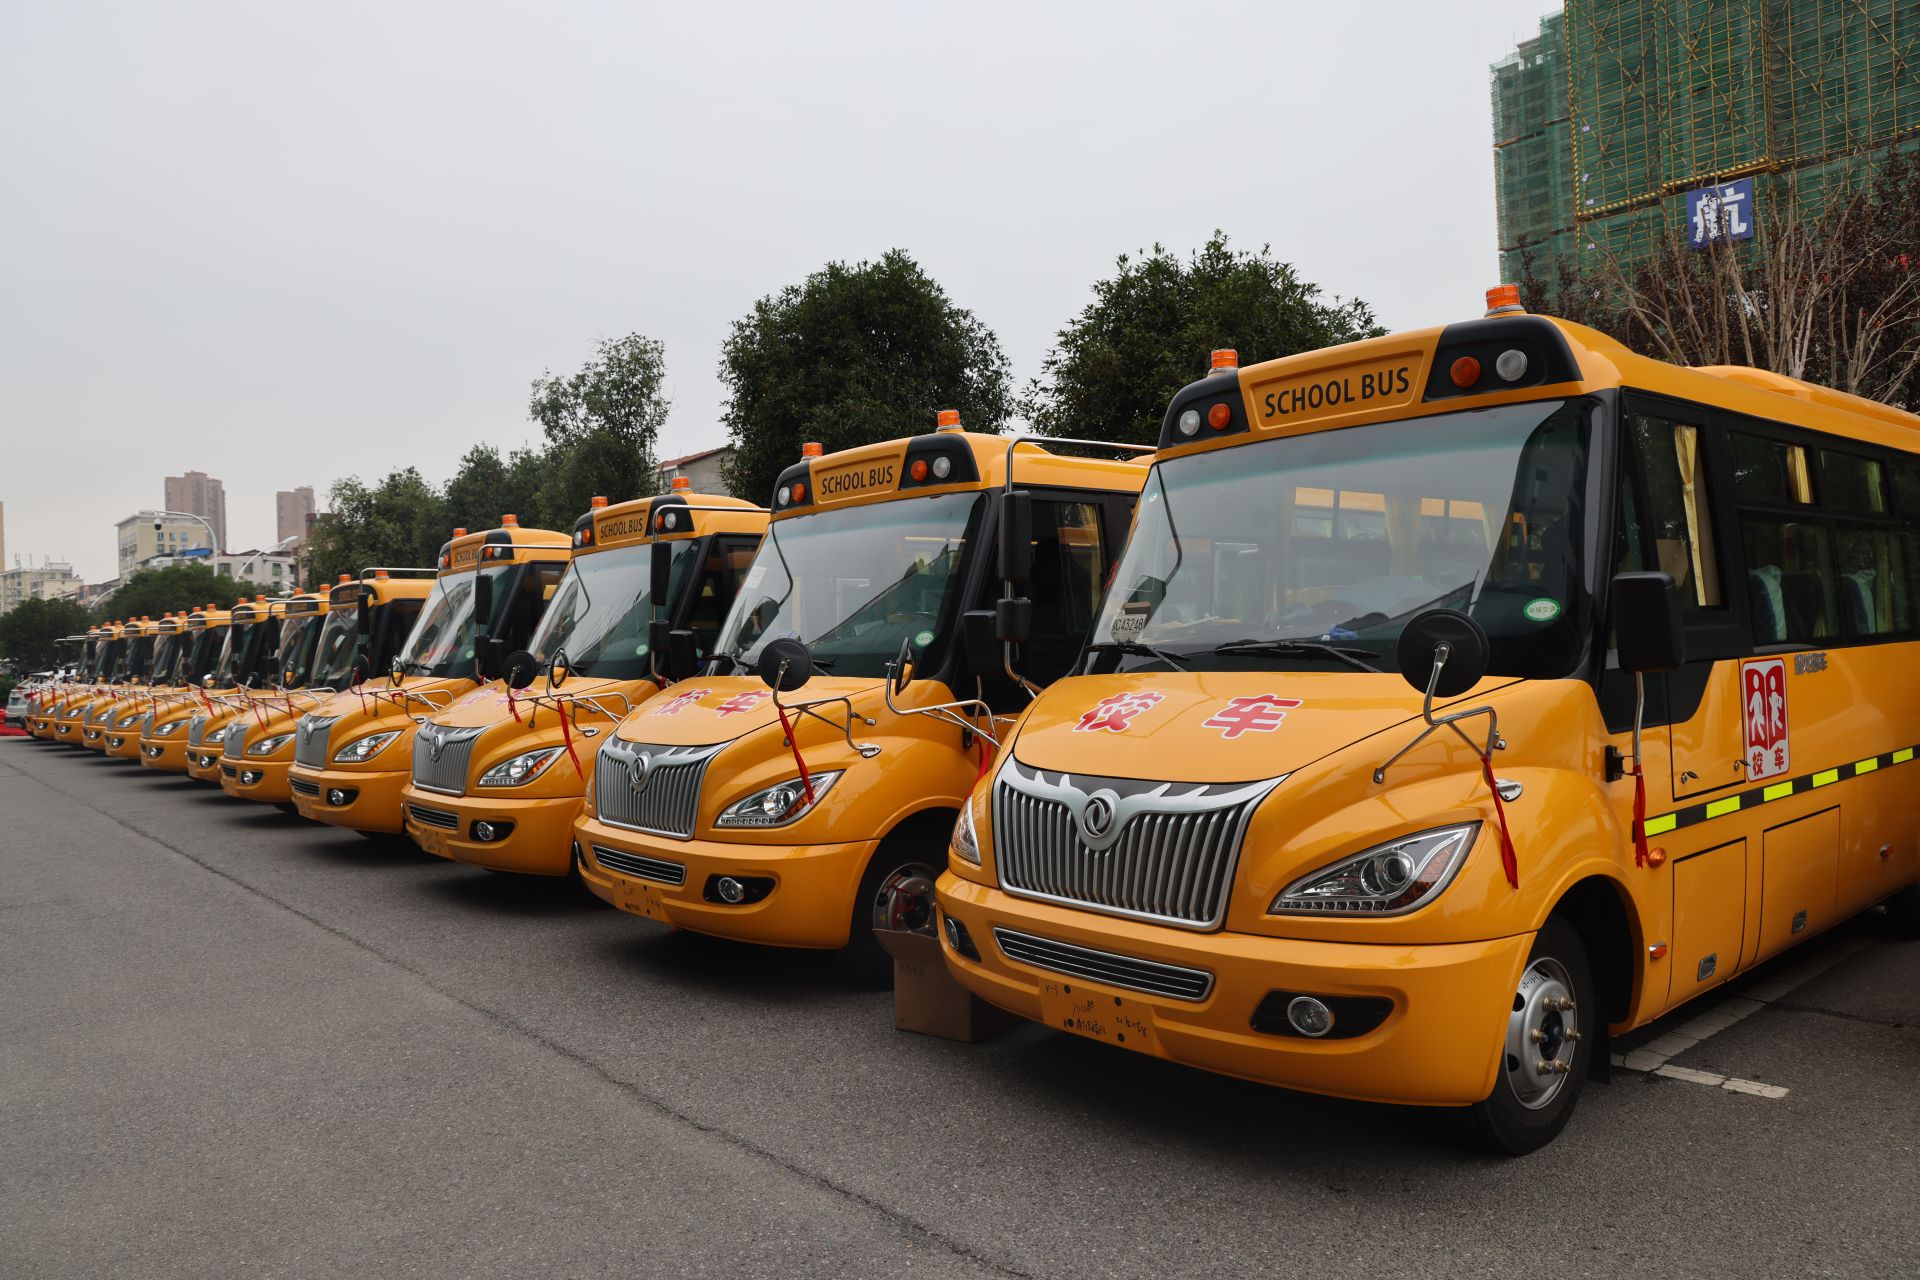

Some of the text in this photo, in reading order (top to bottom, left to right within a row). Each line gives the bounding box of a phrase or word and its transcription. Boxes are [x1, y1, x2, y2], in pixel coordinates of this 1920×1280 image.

[1693, 187, 1748, 242] 航
[1265, 367, 1409, 417] SCHOOL BUS
[821, 465, 893, 495] SCHOOL BUS
[600, 518, 643, 538] SCHOOL BUS
